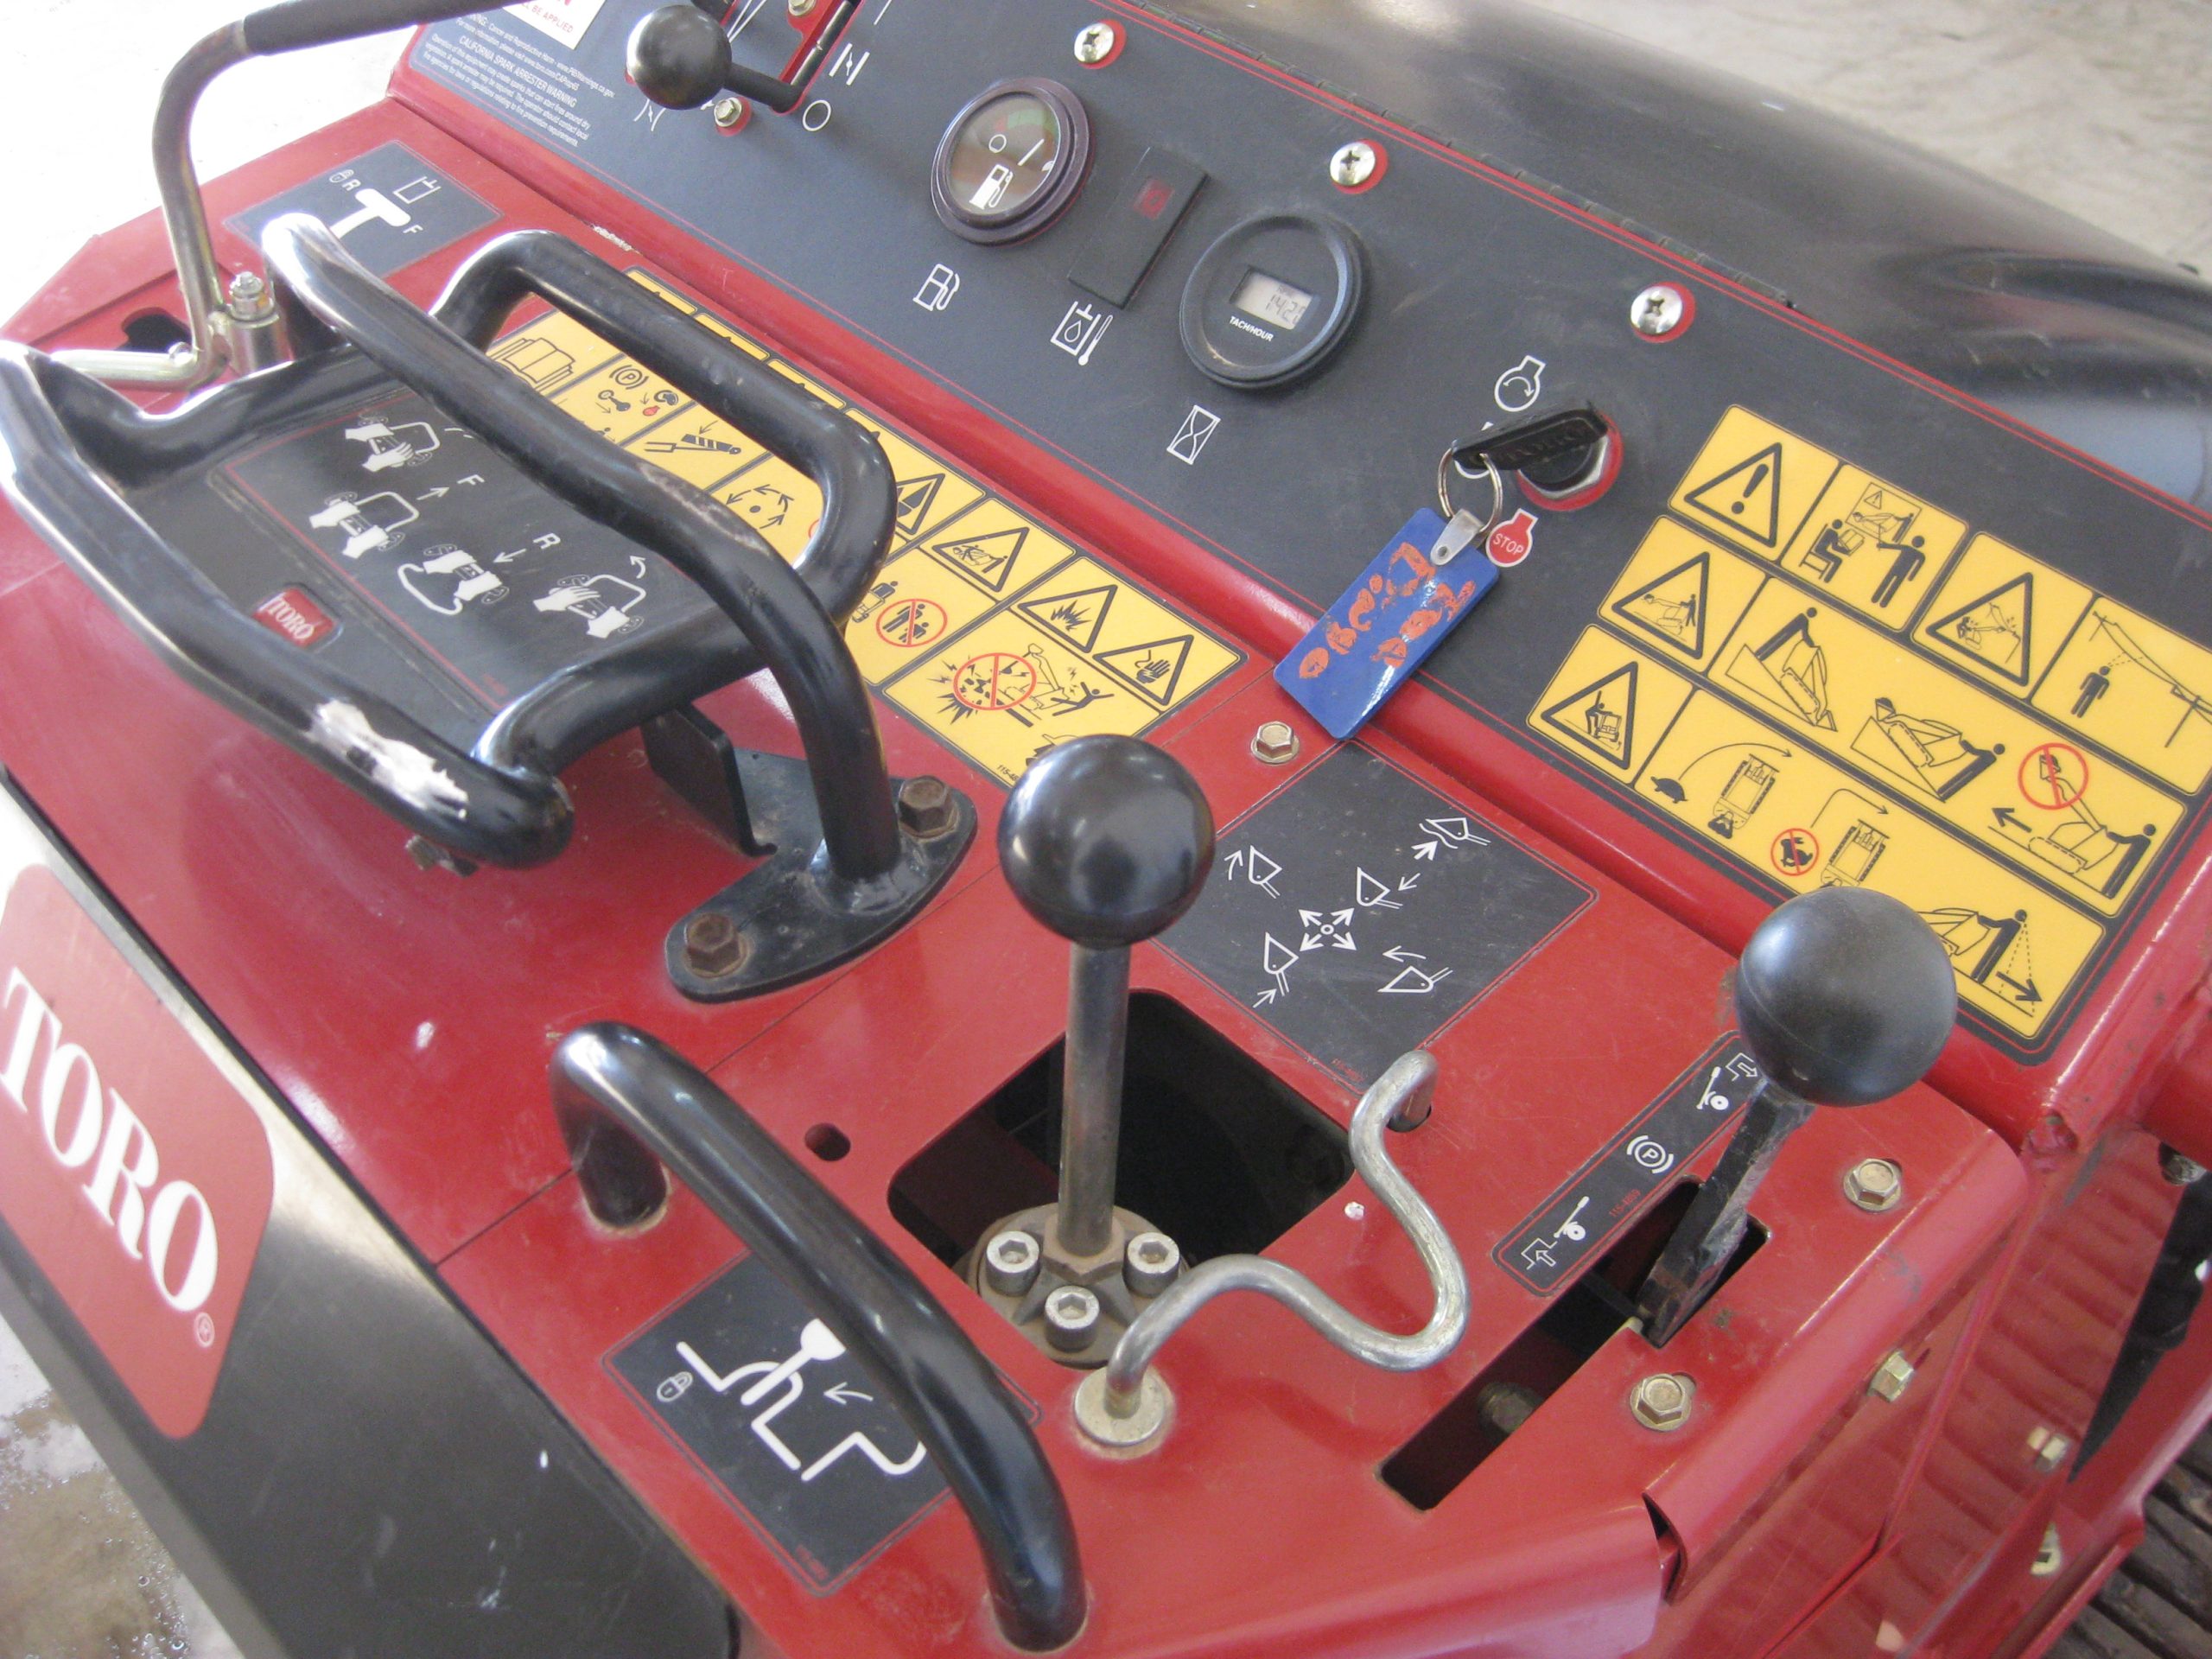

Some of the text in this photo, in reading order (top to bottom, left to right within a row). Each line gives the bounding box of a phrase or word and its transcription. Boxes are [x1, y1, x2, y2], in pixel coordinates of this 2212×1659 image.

[543, 11, 574, 33] APPLIED
[460, 35, 577, 108] CALIFORNIA SPARK ARRESTER WARNING
[342, 178, 361, 192] R
[402, 224, 423, 234] F
[1229, 315, 1274, 342] TACH/HOUR
[456, 474, 486, 486] F
[532, 532, 561, 550] R
[1492, 533, 1524, 556] STOP
[266, 595, 315, 639] TORO
[0, 966, 219, 1313] TORO
